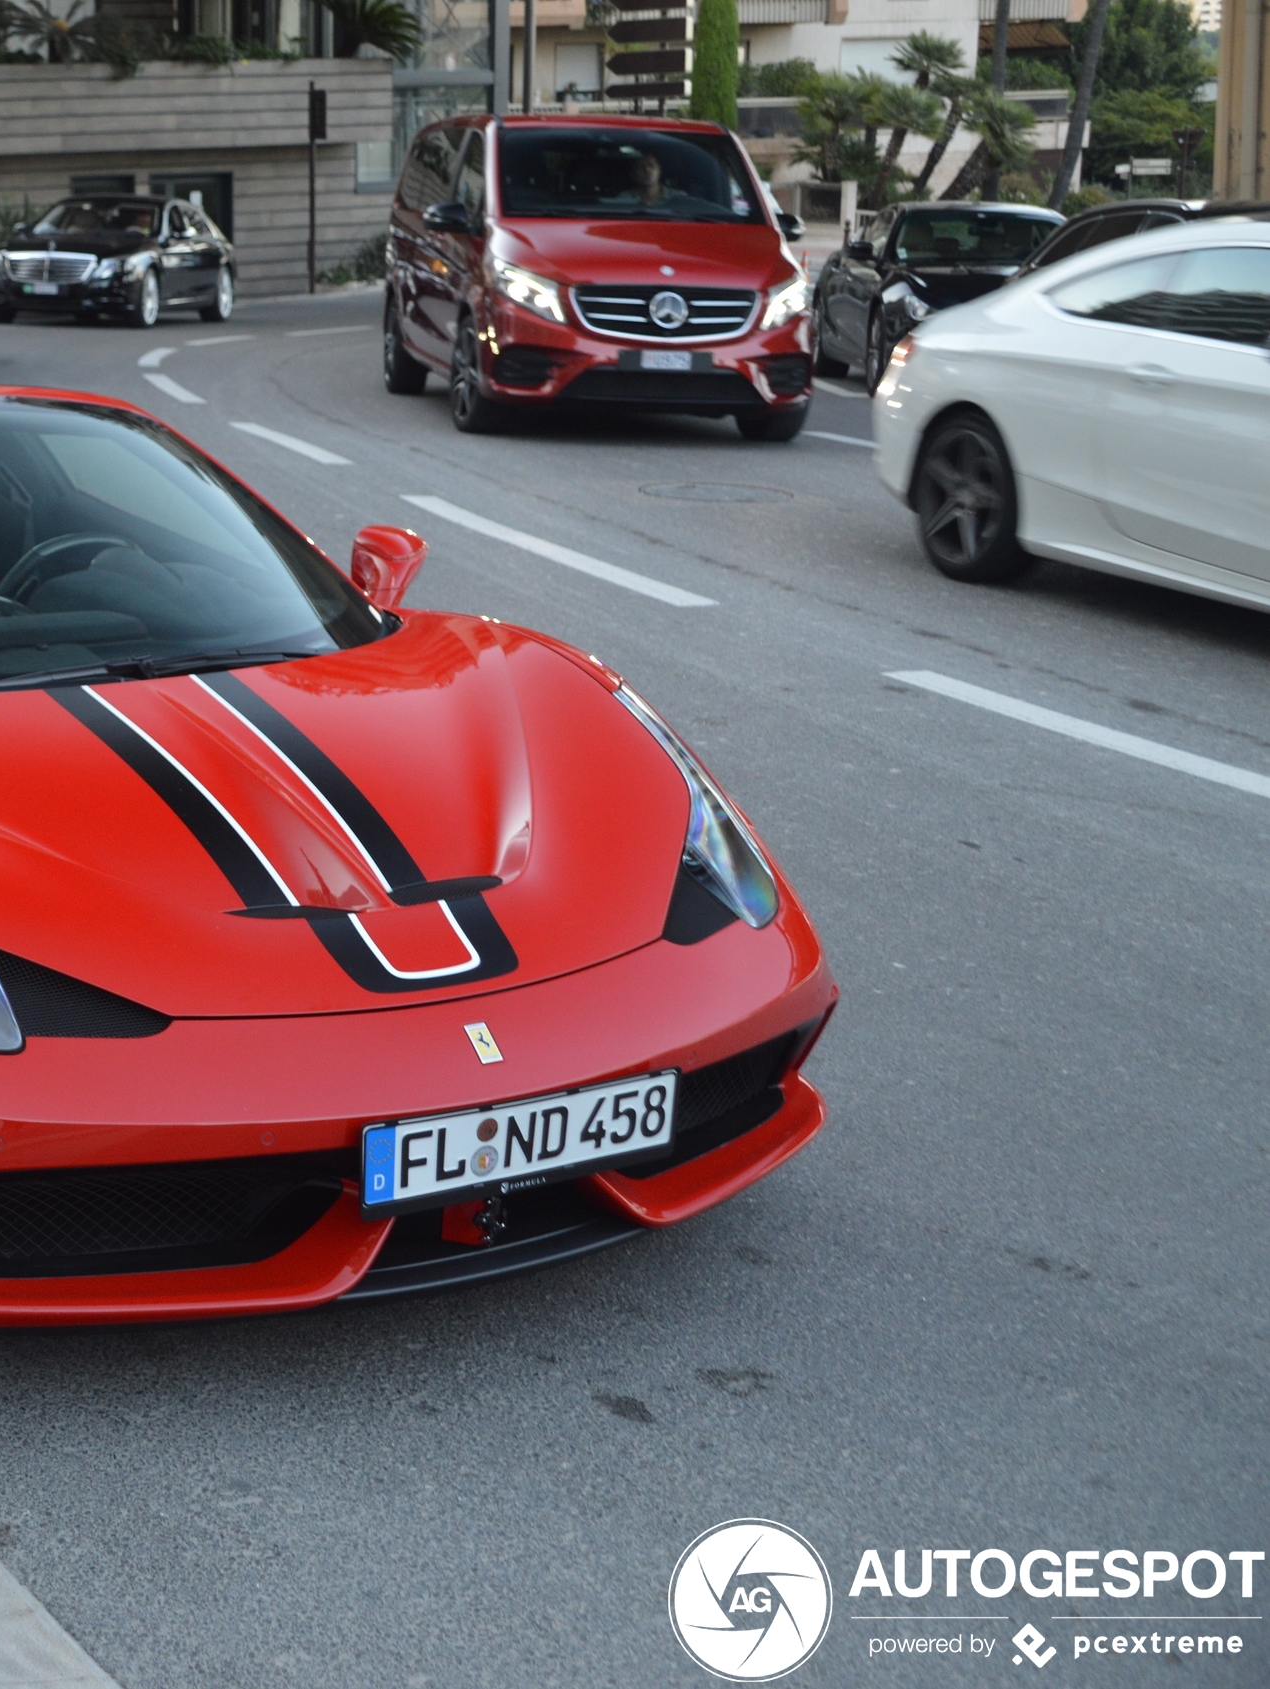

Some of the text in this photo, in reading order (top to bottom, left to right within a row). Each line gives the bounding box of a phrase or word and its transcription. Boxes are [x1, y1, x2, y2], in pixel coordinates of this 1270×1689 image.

[400, 1085, 667, 1188] FL ND 458
[373, 1174, 386, 1191] D
[510, 1176, 547, 1190] FORMULA
